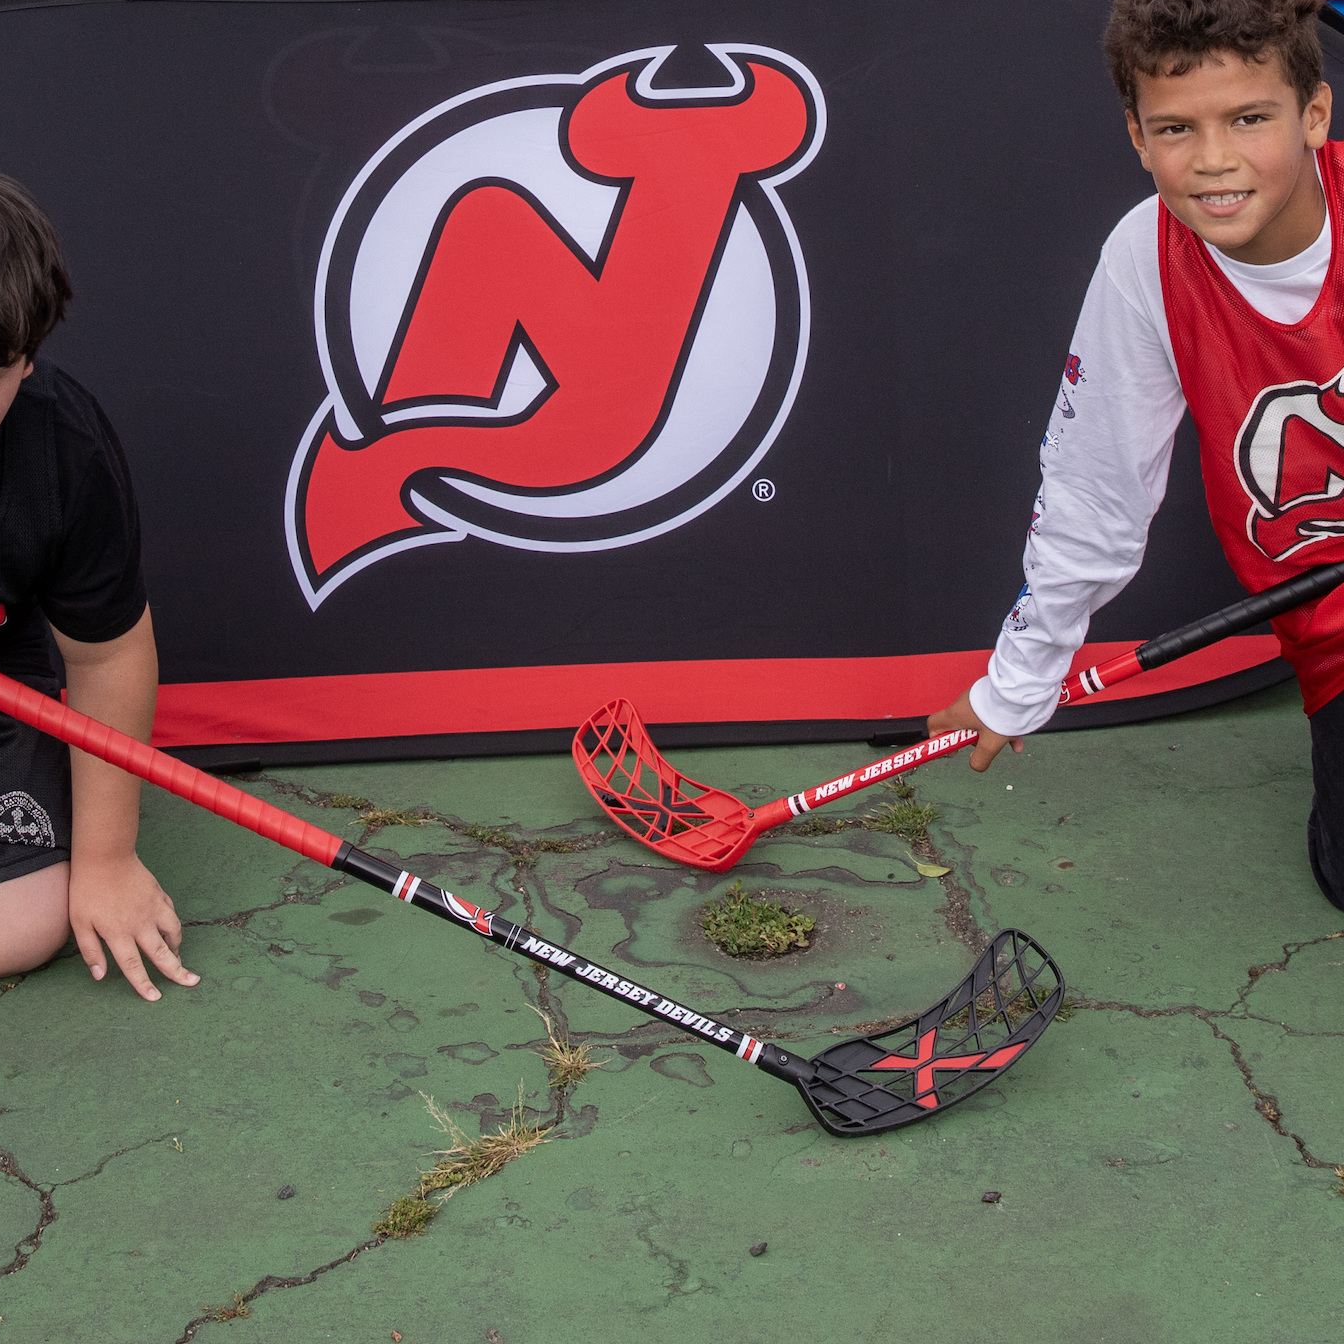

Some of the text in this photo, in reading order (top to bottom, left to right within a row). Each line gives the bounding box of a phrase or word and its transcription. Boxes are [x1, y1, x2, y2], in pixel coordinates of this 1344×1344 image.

[814, 728, 978, 801] NEW JERSEY DEVIL
[520, 935, 734, 1042] NEW JERSEY DEVILS
